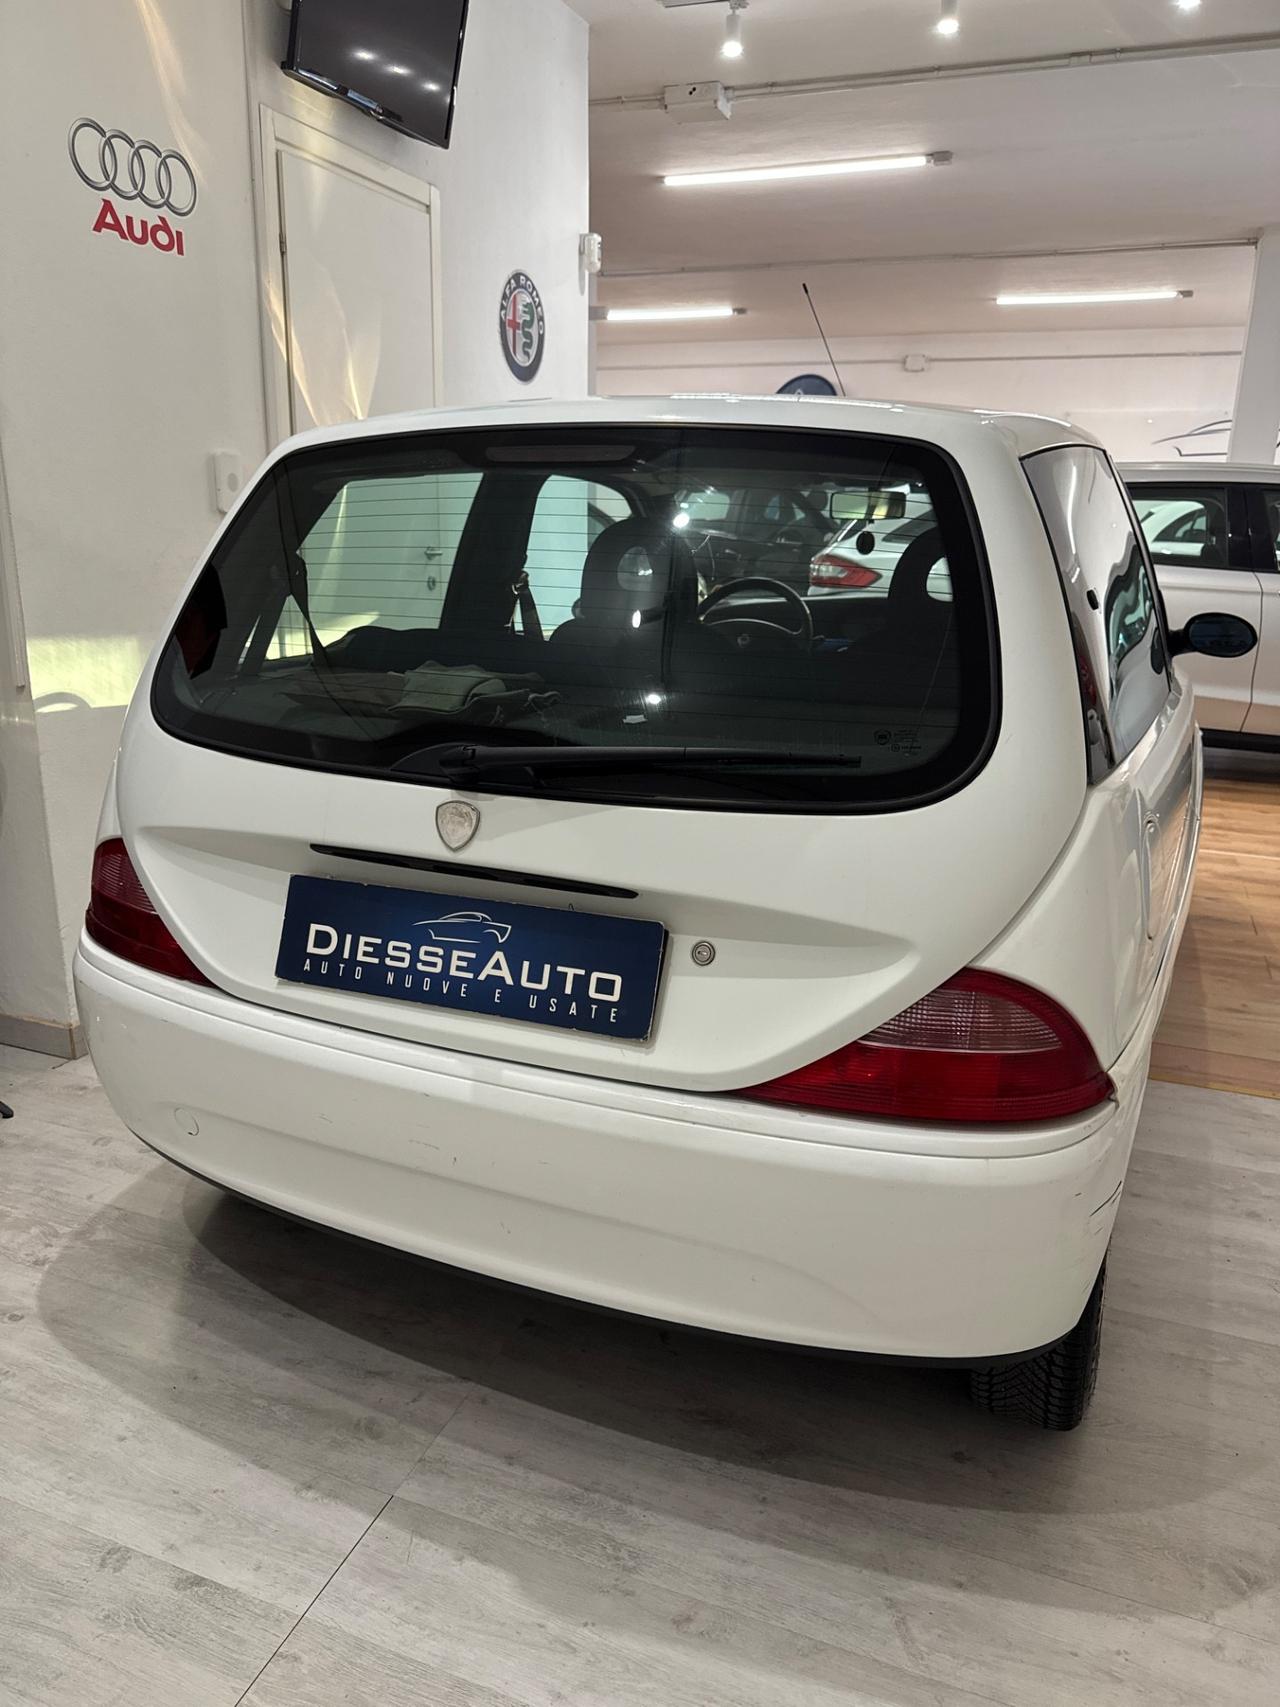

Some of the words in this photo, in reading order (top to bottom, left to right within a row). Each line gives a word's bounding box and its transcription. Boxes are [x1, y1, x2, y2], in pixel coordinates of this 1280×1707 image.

[93, 198, 184, 256] Audi
[500, 279, 517, 321] ALFA
[303, 958, 363, 980] AUTO
[386, 971, 469, 998] NUOVE
[494, 989, 502, 1003] E
[529, 994, 618, 1023] USATE
